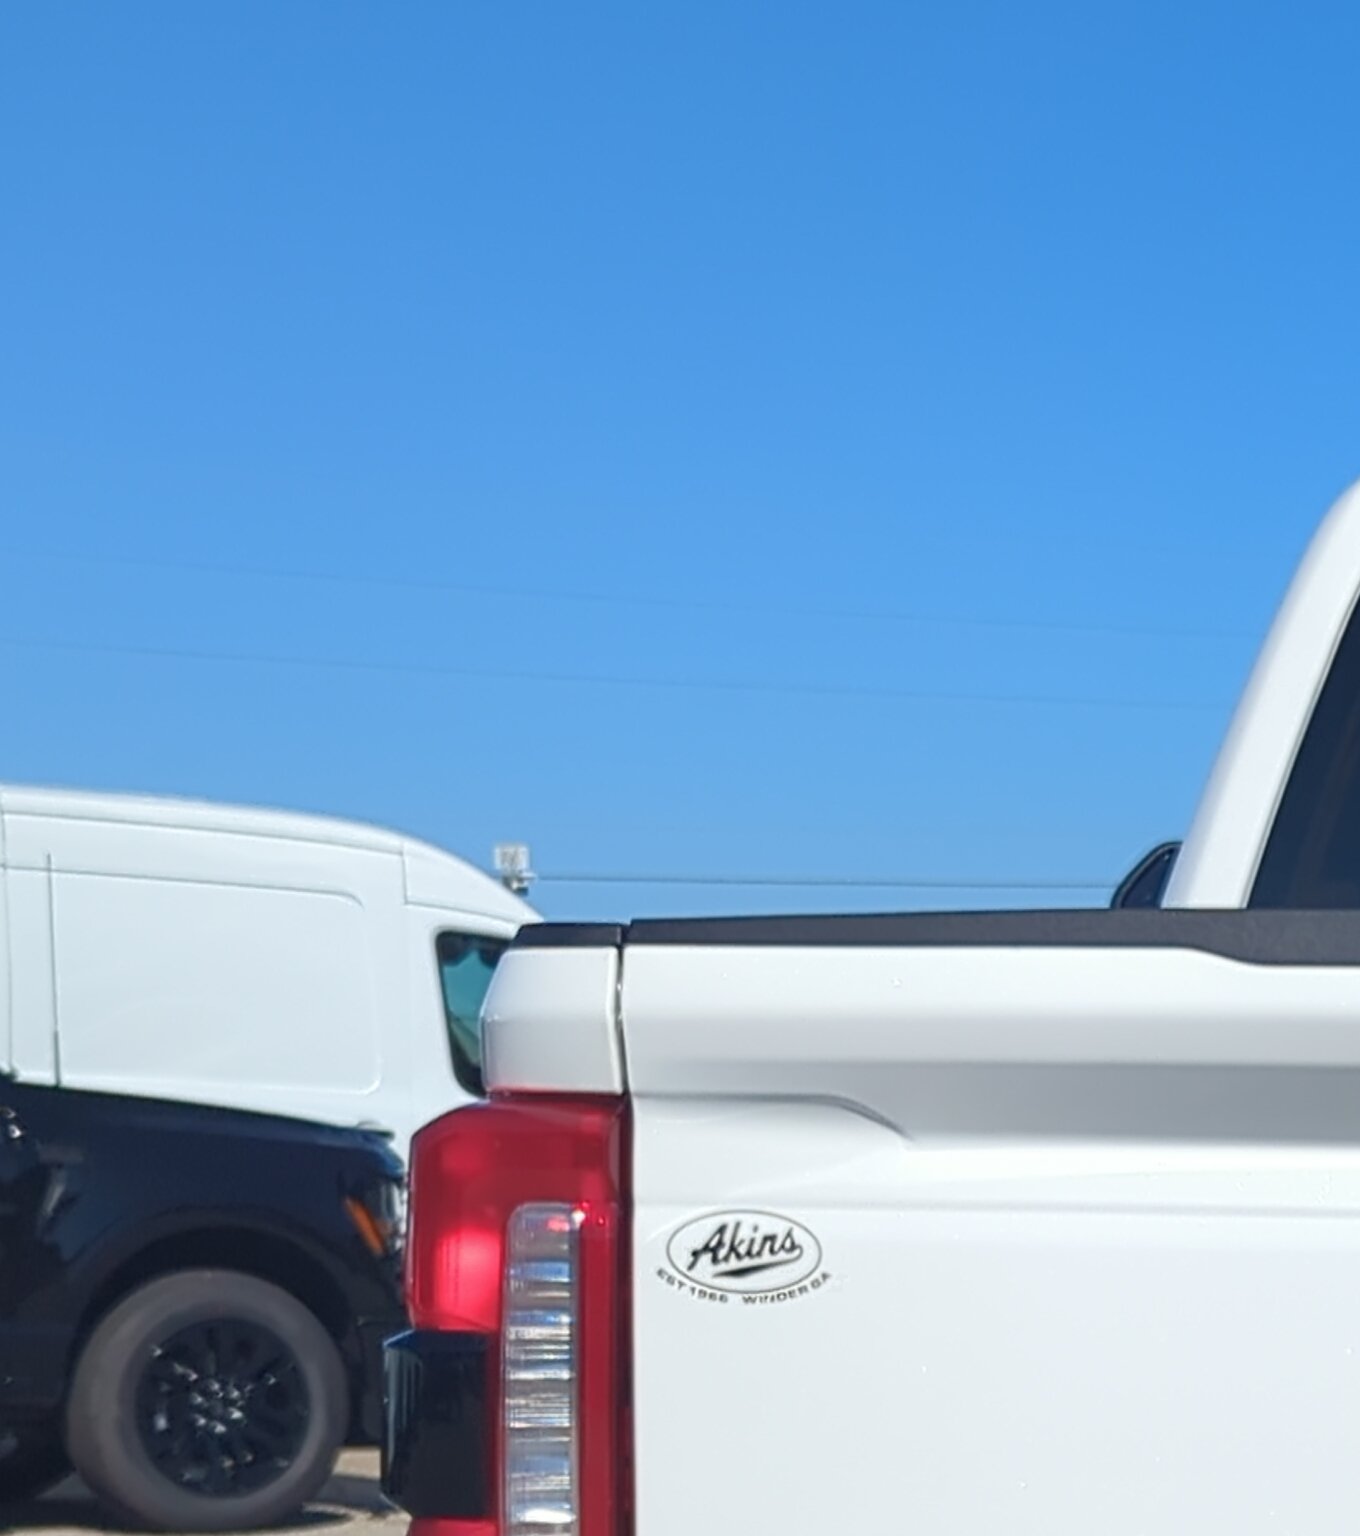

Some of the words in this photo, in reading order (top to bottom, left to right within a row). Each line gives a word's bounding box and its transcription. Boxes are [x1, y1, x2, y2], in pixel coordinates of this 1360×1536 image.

[687, 1221, 799, 1271] Akins
[656, 1268, 687, 1290] EST
[742, 1284, 809, 1304] WINDER
